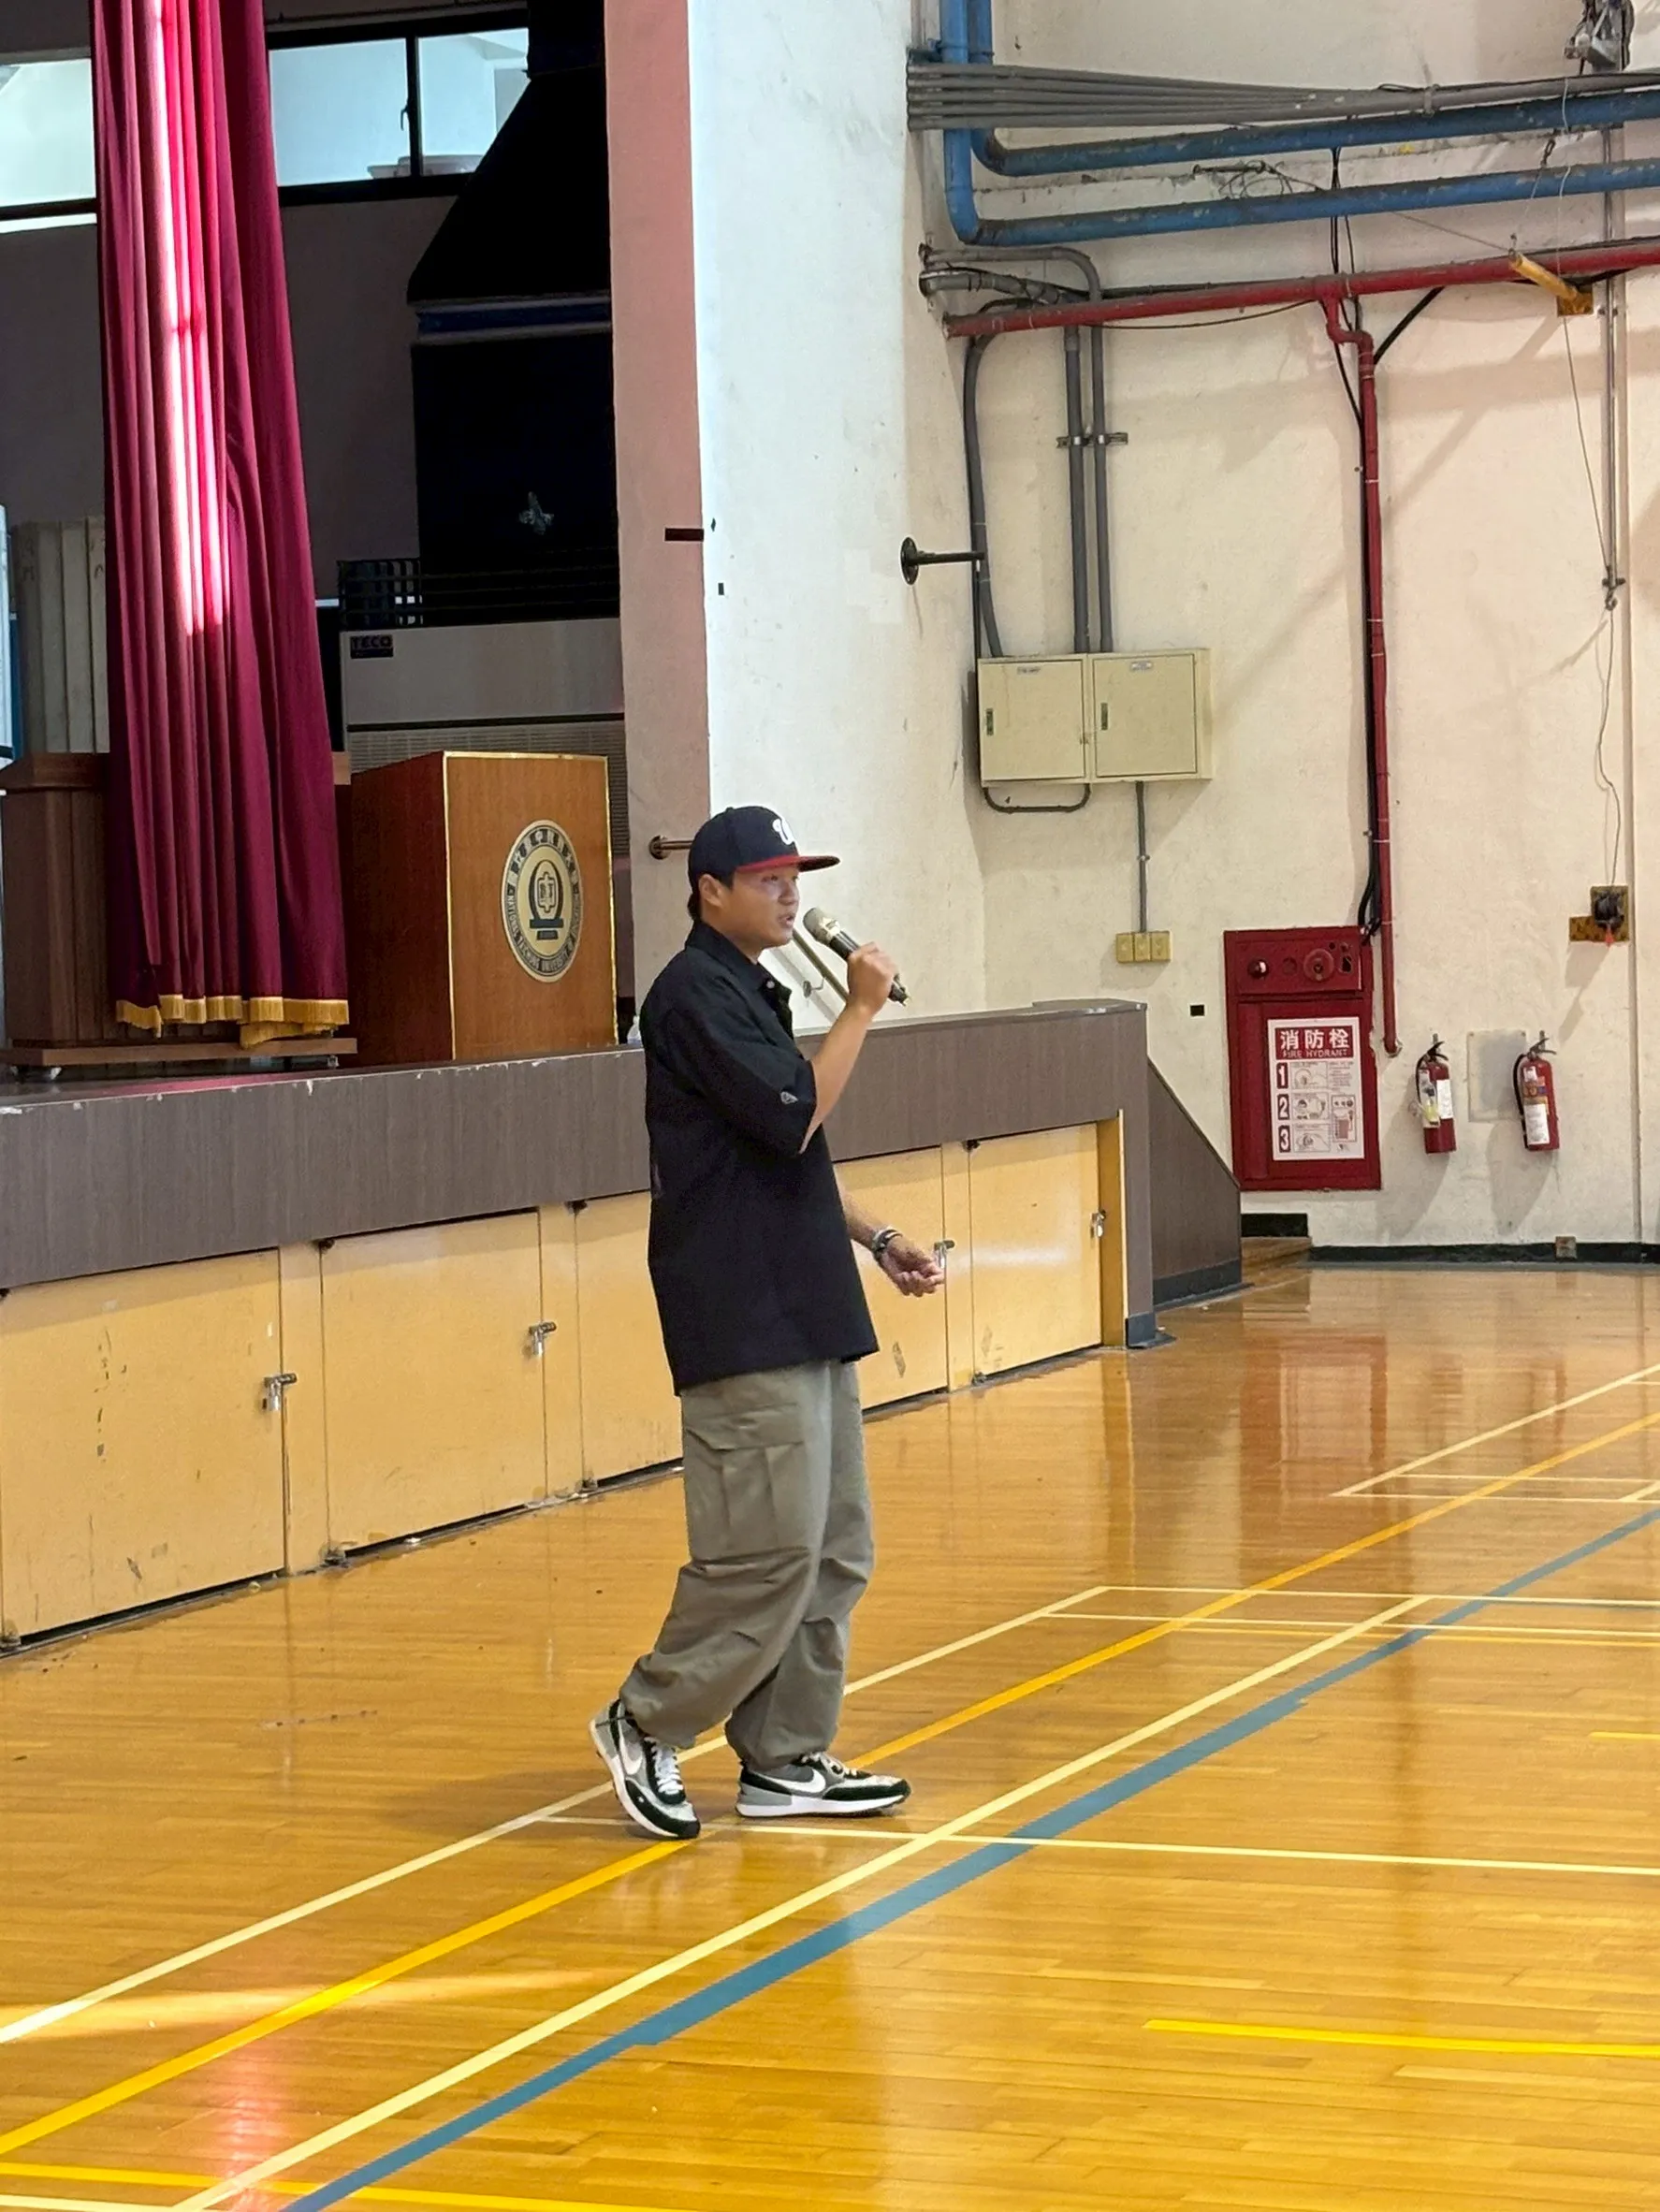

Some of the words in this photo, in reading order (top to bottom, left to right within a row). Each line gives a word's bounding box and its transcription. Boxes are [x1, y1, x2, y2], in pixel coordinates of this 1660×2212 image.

[1280, 1028, 1349, 1051] 消防栓
[1282, 1050, 1303, 1058] FIRE
[1278, 1065, 1286, 1086] 1
[1279, 1097, 1289, 1120] 2
[1280, 1128, 1289, 1150] 3
